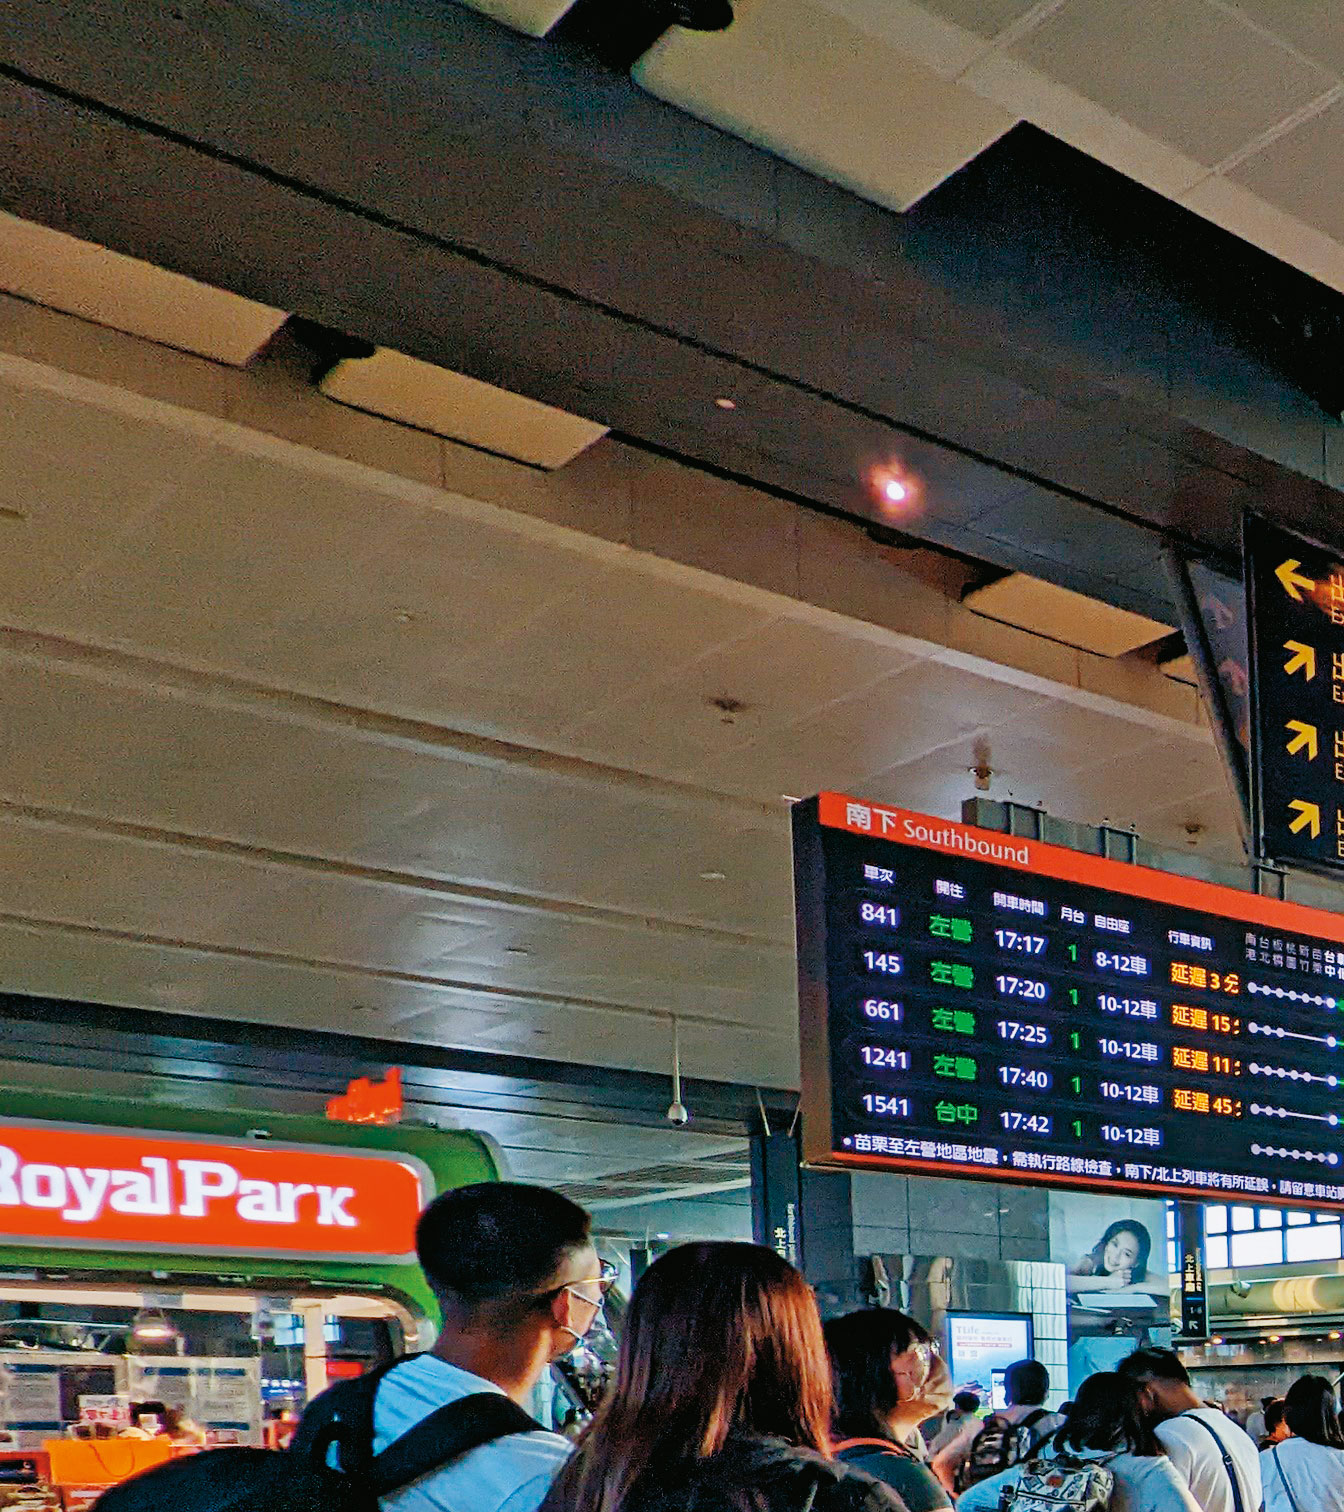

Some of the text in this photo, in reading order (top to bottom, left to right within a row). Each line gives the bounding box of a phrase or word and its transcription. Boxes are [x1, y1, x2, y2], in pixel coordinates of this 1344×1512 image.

[846, 803, 1029, 865] 南下 Southbound
[864, 864, 894, 884] 車次
[936, 879, 964, 898] 開往
[861, 903, 897, 926] 841
[993, 891, 1045, 916] 開車時間
[1061, 906, 1085, 924] 月台
[1094, 915, 1130, 934] 自由座
[994, 930, 1045, 954] 17:17
[1168, 930, 1212, 951] 行車資訊
[864, 951, 901, 974] 145
[1068, 943, 1077, 962] 1
[1096, 951, 1147, 975] 8-12車
[996, 975, 1046, 999] 17:20
[1171, 962, 1207, 988] 延遲
[1210, 973, 1221, 990] 3
[1068, 988, 1078, 1006] 1
[1098, 995, 1157, 1019] 10-12車
[865, 1000, 899, 1021] 661
[1172, 1005, 1208, 1030] 延遲
[1212, 1015, 1231, 1033] 15
[997, 1021, 1047, 1044] 17:25
[1070, 1032, 1080, 1049] 1
[861, 1046, 907, 1070] 1241
[1099, 1039, 1158, 1061] 10-12車
[1173, 1047, 1208, 1071] 延遲
[1213, 1056, 1230, 1073] 11
[999, 1066, 1048, 1088] 17:40
[1071, 1076, 1081, 1094] 1
[1100, 1082, 1159, 1104] 10-12車
[1174, 1089, 1210, 1113] 延遲
[1213, 1098, 1232, 1114] 45
[863, 1094, 908, 1116] 1541
[935, 1100, 978, 1125] 台中
[1000, 1112, 1049, 1133] 17:42
[1072, 1120, 1082, 1138] 1
[1101, 1126, 1160, 1147] 10-12車
[178, 1158, 358, 1228] Park
